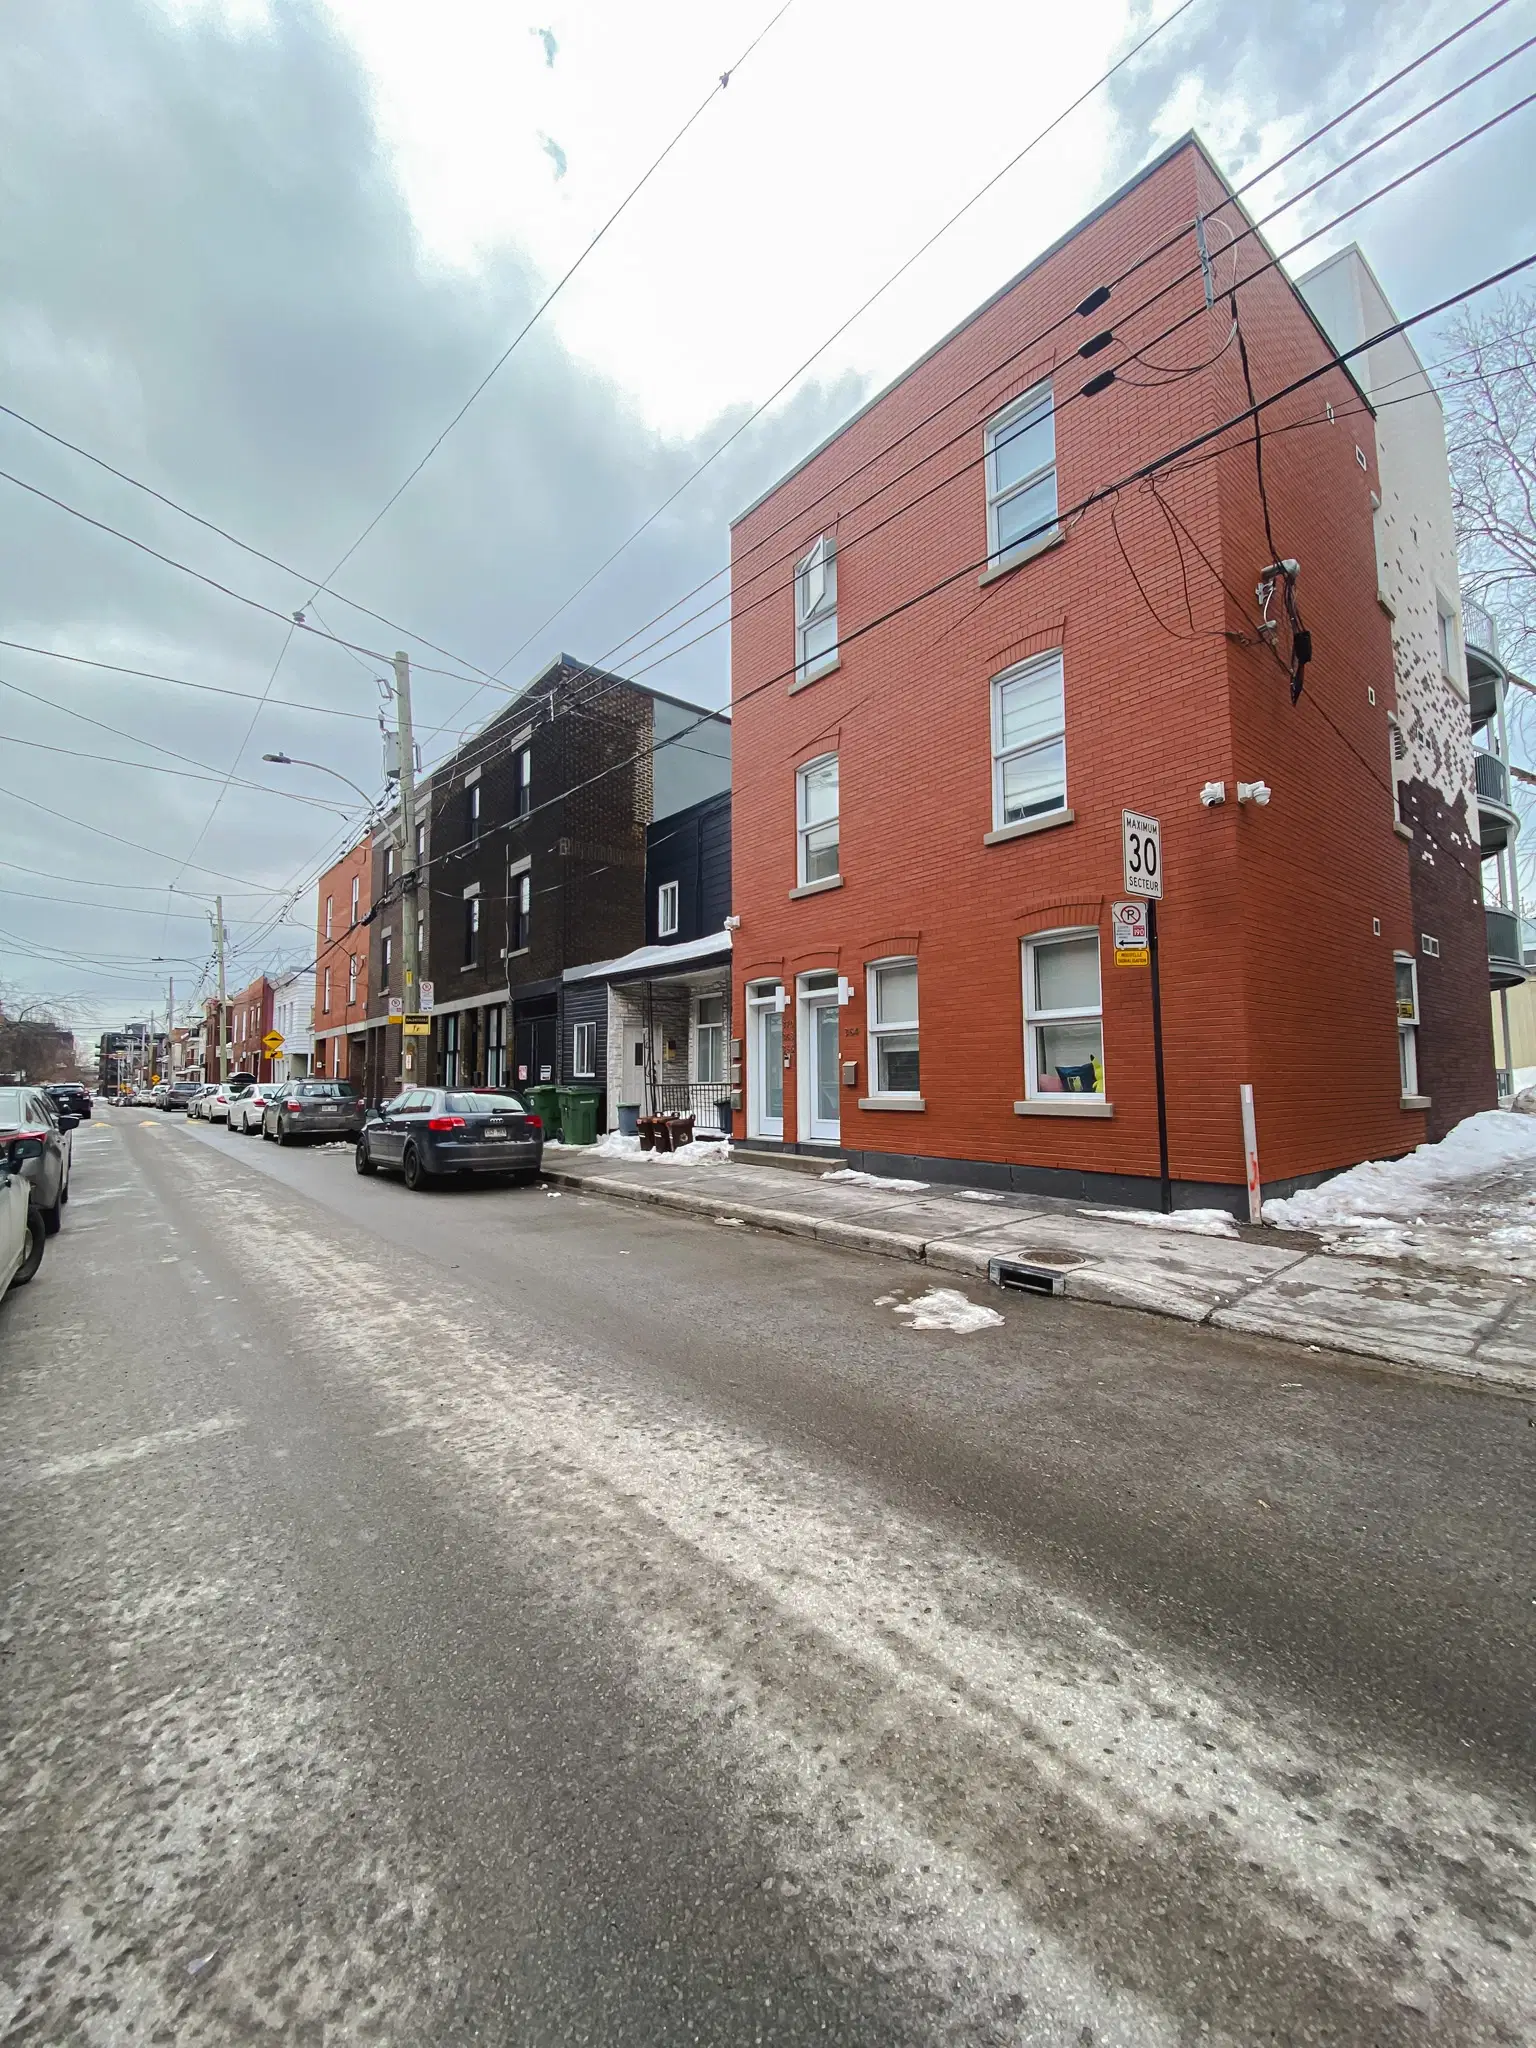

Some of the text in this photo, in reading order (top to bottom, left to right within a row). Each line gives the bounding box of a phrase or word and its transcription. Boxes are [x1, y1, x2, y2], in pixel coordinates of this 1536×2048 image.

[1126, 817, 1158, 834] MAXIMUM
[1129, 833, 1157, 876] 30
[1129, 876, 1159, 891] SECTEUR
